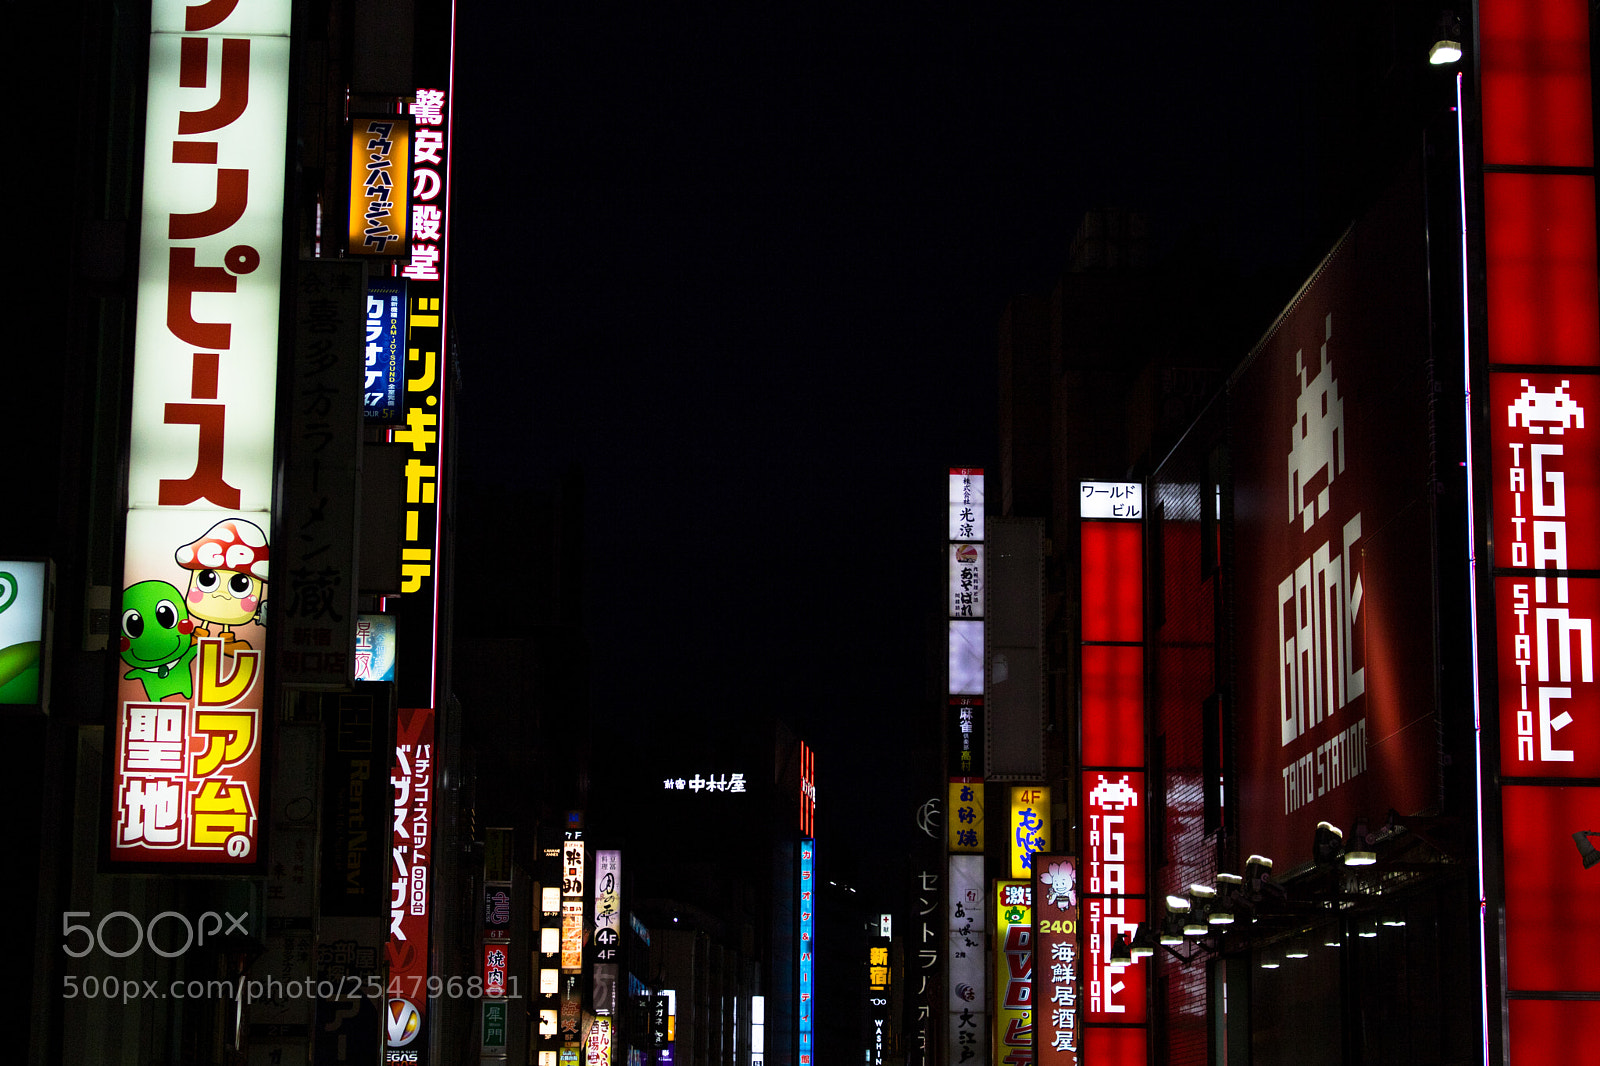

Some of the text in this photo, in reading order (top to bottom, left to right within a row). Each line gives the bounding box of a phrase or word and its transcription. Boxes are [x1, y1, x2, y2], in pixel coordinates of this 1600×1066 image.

[364, 121, 399, 253] タウンハウジング
[401, 88, 445, 281] 驚安の殿堂
[159, 0, 260, 510] リンピース
[394, 297, 440, 593] ドン・キホーテ
[1081, 485, 1137, 500] ワールド
[1112, 504, 1140, 518] ビル
[1278, 511, 1366, 748] GAME
[1509, 443, 1534, 762] TAITO STATION
[1530, 444, 1594, 761] GAME
[187, 637, 262, 858] レア台の
[959, 706, 973, 733] 麻雀
[116, 702, 190, 850] 聖地
[1021, 790, 1042, 804] 4F
[1282, 717, 1368, 816] TAITO STATION
[412, 744, 431, 864] パチンコ・スロット
[957, 785, 979, 847] お好焼
[565, 831, 583, 840] 7F
[412, 868, 426, 914] 900台
[491, 891, 510, 926] HUB
[1090, 815, 1101, 1013] TAITO STATION
[597, 934, 617, 945] 4F
[597, 949, 616, 960] 4F
[1039, 920, 1077, 934] 240
[487, 949, 505, 987] 焼肉
[869, 946, 888, 985] 新宿
[1051, 941, 1077, 1053] 海鮮居酒屋
[958, 1008, 977, 1064] 大江戸
